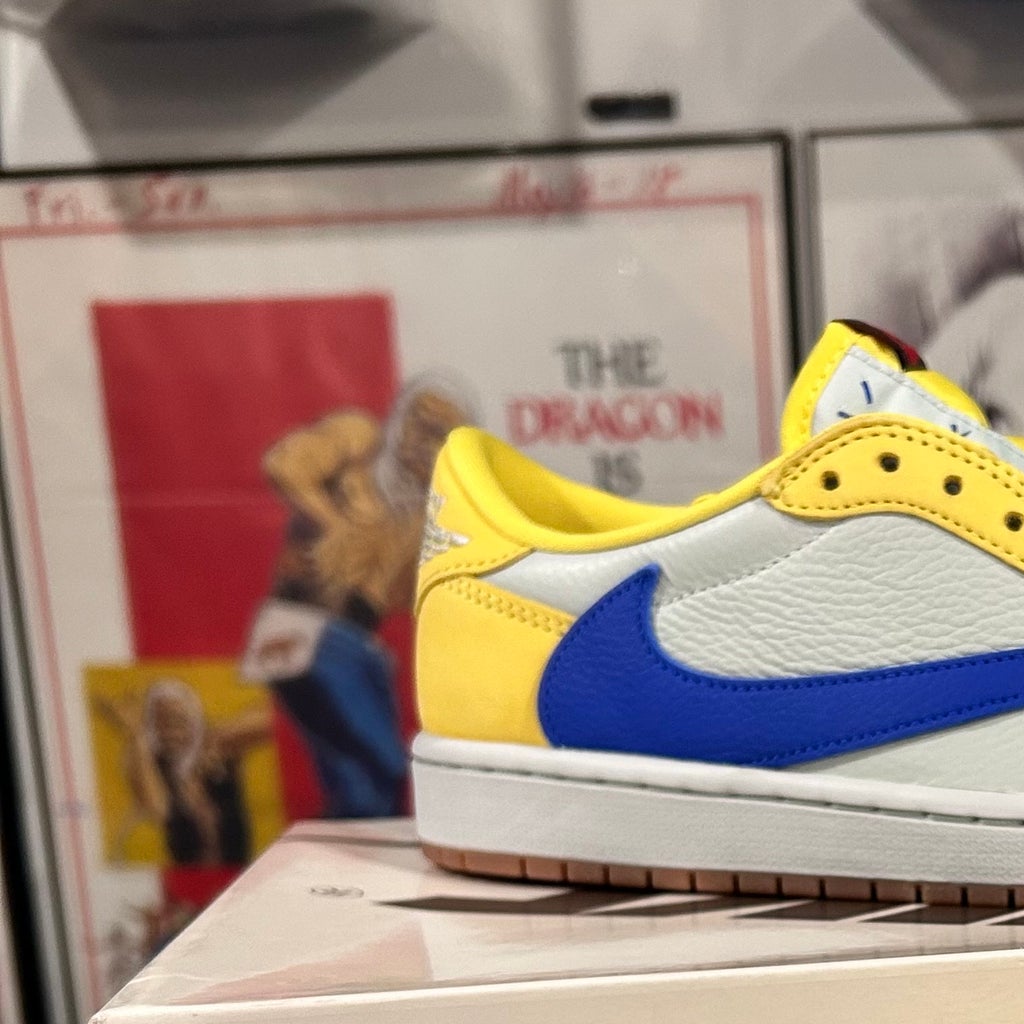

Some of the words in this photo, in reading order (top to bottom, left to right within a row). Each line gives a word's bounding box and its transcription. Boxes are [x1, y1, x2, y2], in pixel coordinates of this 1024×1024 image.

[554, 336, 667, 389] THE
[505, 391, 722, 445] DRAGON
[591, 452, 644, 497] IS
